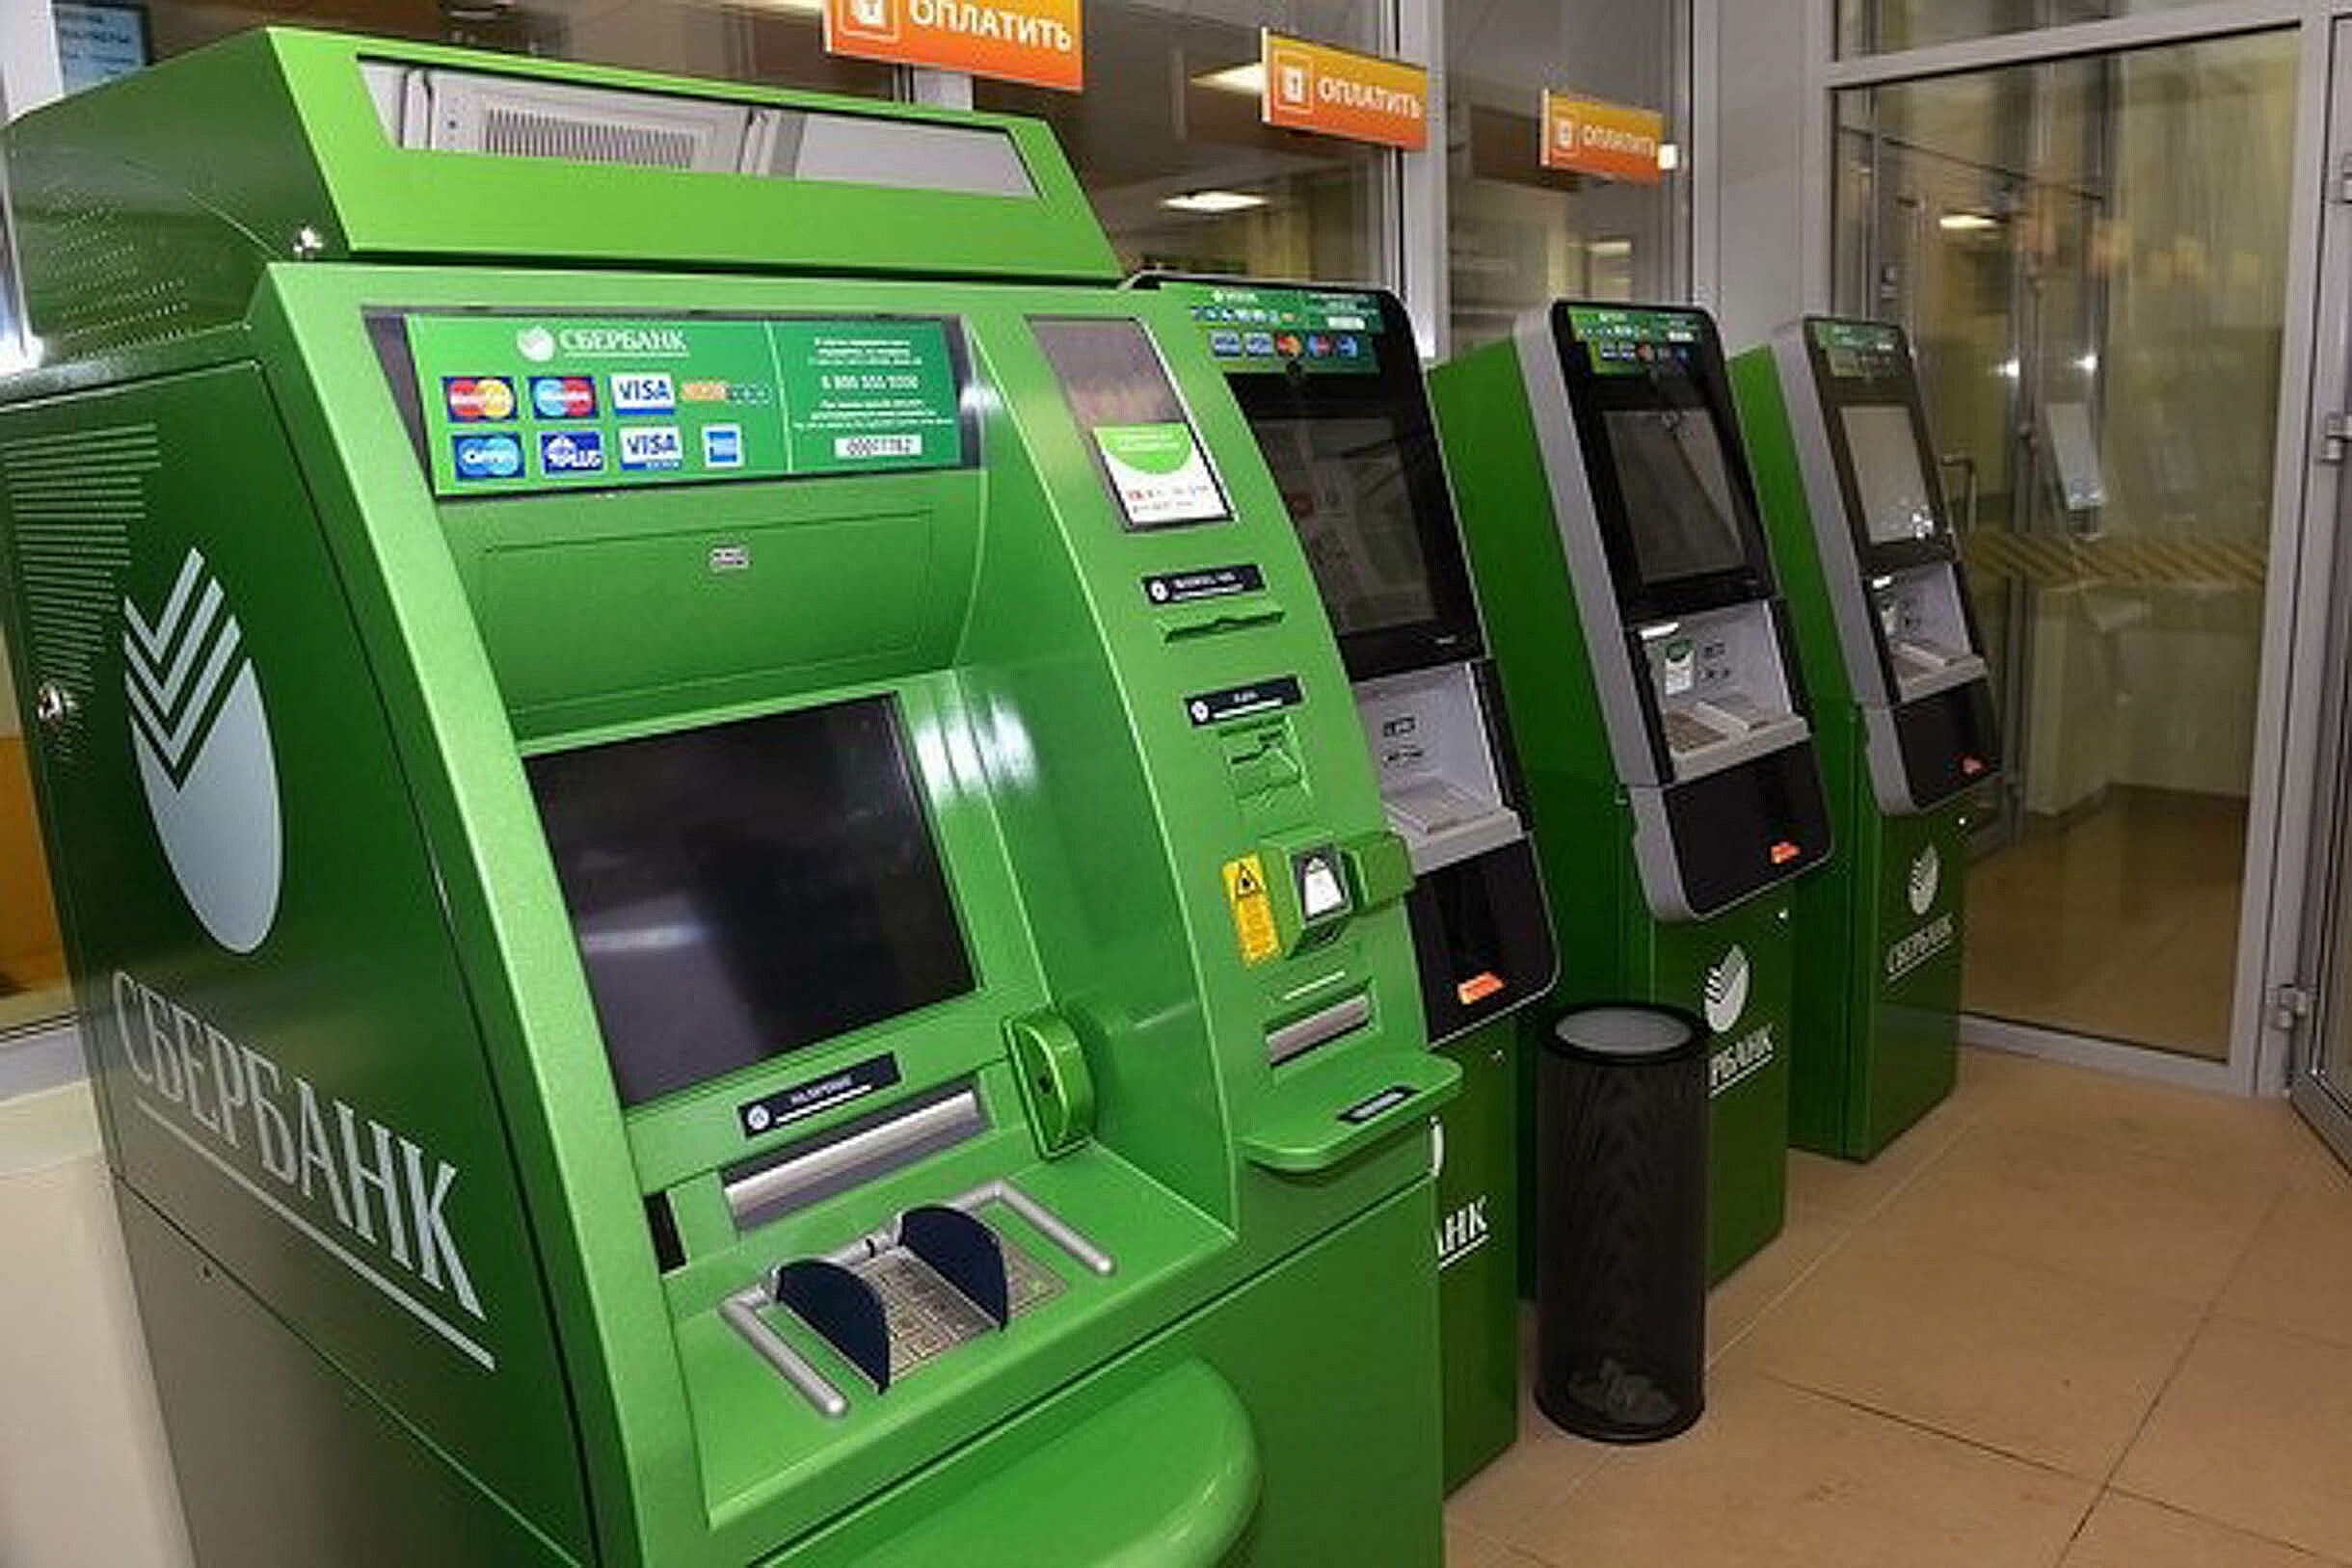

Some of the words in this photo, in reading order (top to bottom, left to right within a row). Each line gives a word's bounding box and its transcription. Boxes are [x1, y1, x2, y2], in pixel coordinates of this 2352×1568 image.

[909, 0, 1072, 52] ОПЛАТИТЬ
[557, 328, 688, 351] СБЕРБАНК
[618, 379, 671, 401] VISA
[627, 434, 678, 456] VISA
[113, 970, 486, 1322] СБЕРБАНК
